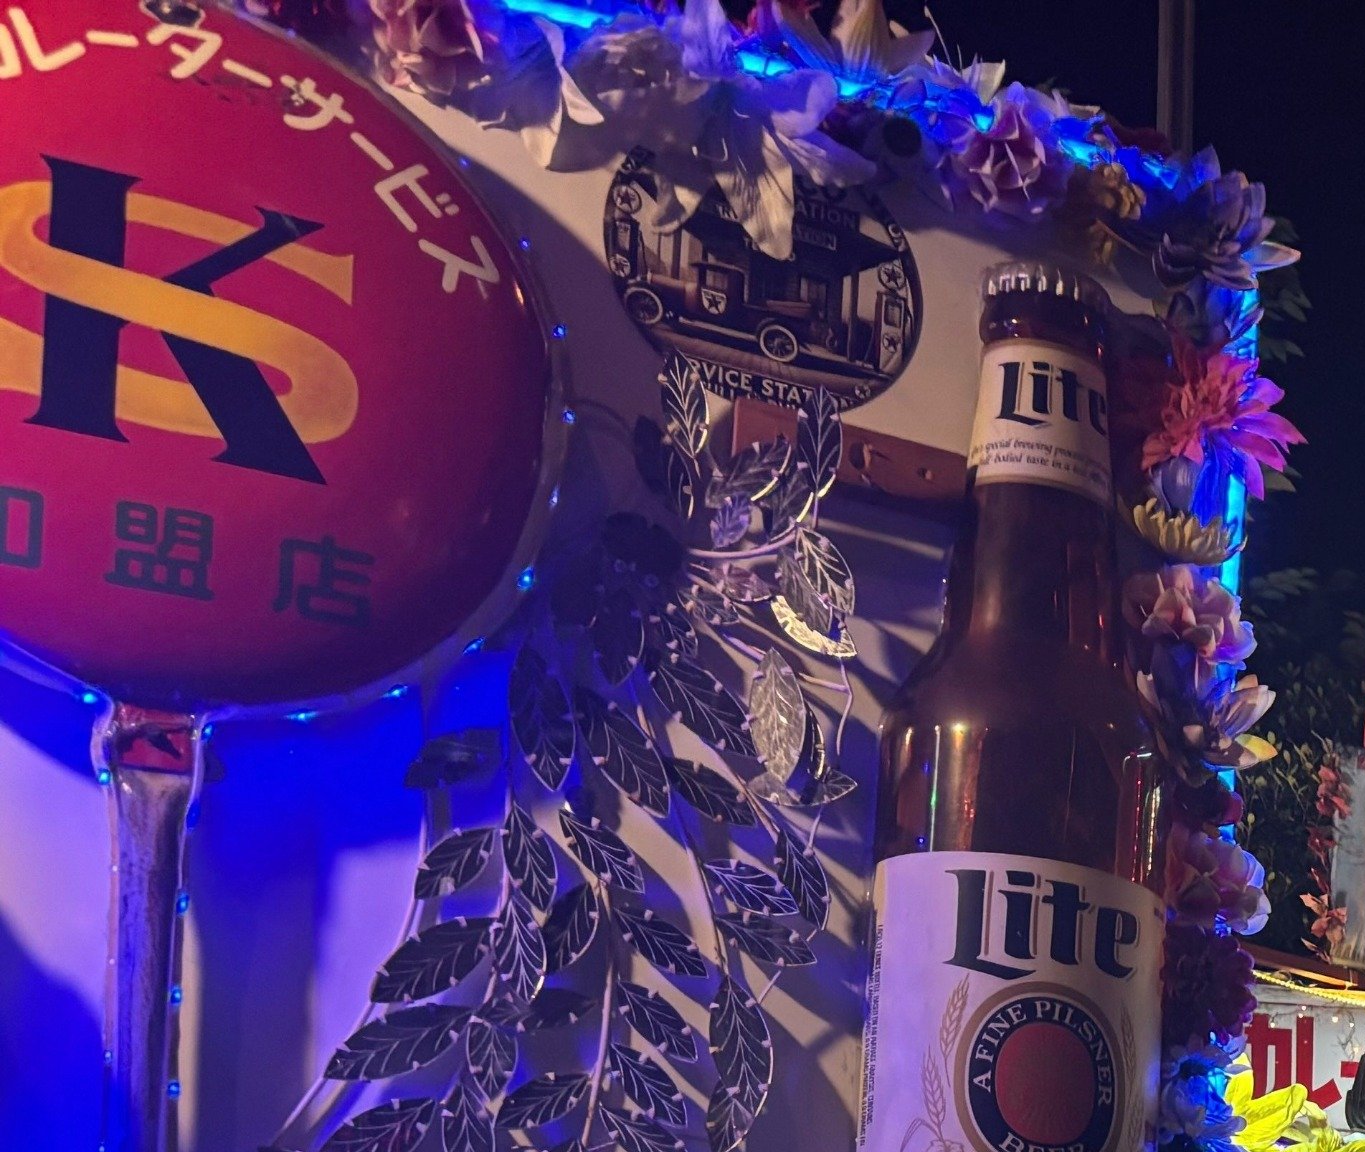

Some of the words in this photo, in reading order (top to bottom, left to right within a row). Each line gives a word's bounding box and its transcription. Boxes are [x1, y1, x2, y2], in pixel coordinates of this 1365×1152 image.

[943, 868, 1141, 980] Lite
[973, 1069, 992, 1093] A
[975, 1003, 1028, 1063] FINE
[1034, 1000, 1113, 1106] PILSNER
[1245, 1013, 1360, 1110] カレ
